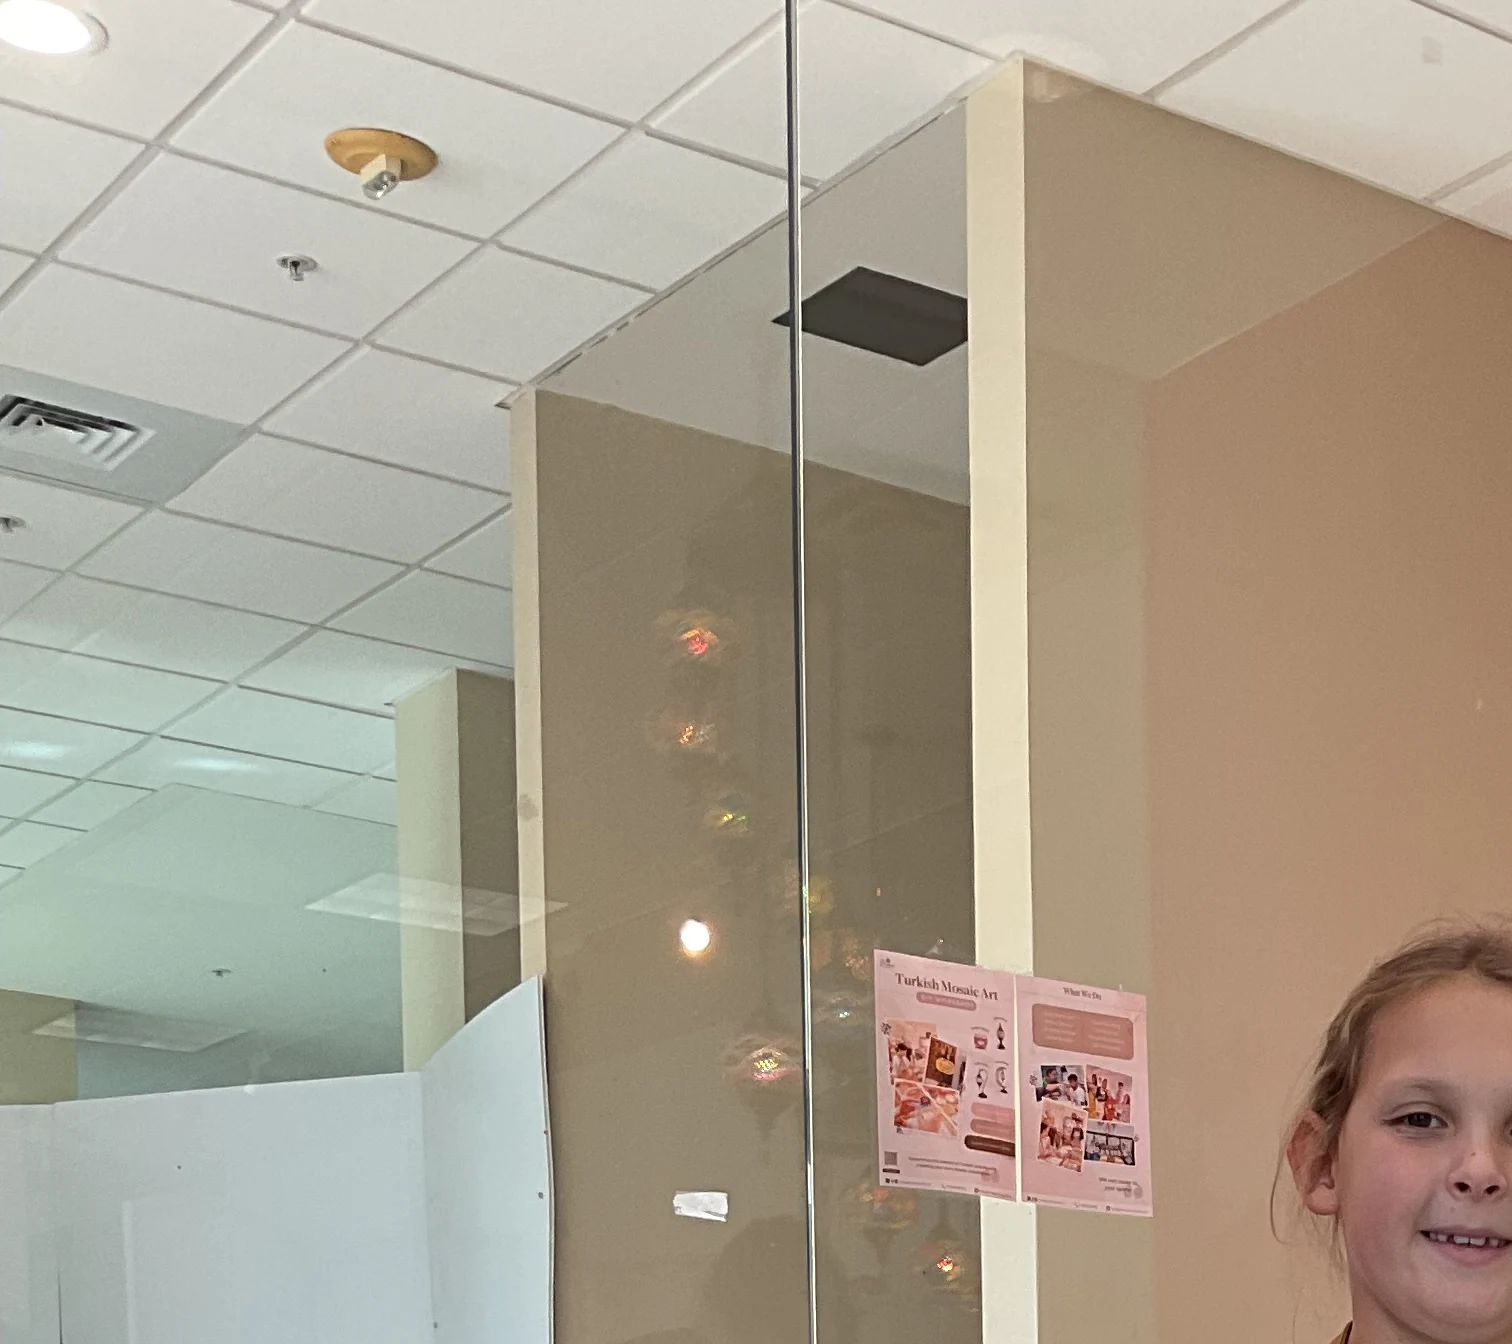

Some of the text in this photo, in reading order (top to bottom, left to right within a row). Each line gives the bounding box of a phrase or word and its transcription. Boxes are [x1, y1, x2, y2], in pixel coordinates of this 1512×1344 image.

[895, 972, 939, 991] Turkish
[941, 980, 979, 998] Mosaic
[982, 987, 998, 1001] Art
